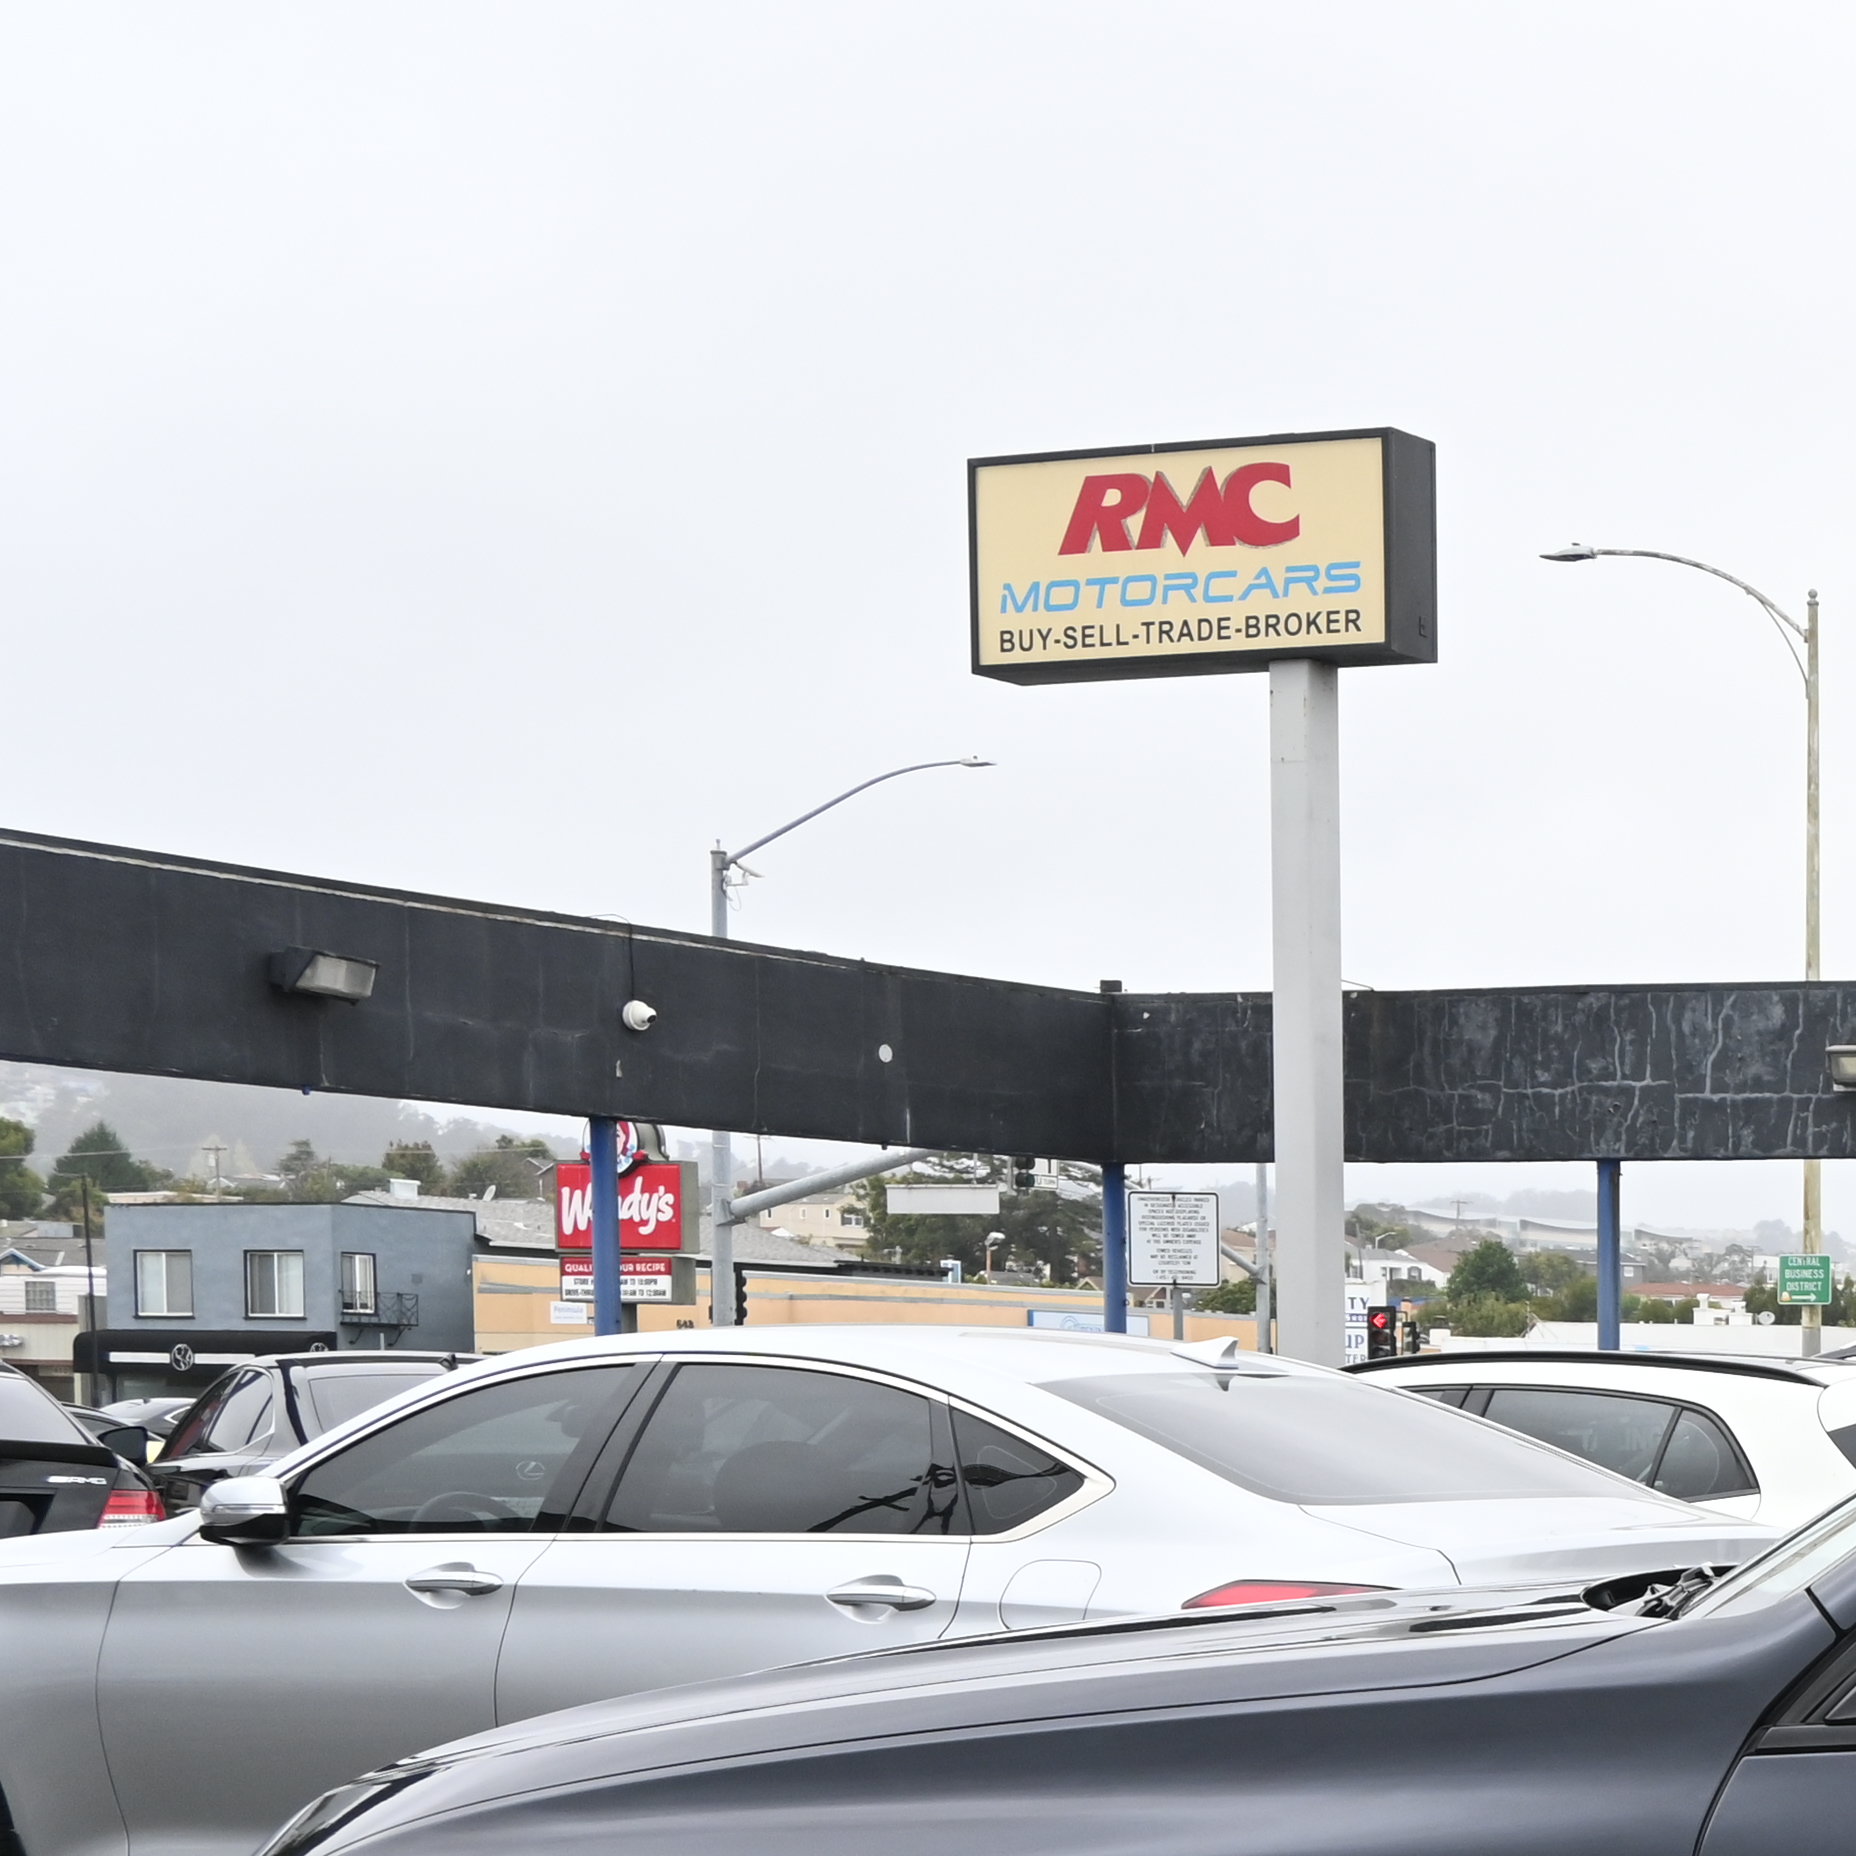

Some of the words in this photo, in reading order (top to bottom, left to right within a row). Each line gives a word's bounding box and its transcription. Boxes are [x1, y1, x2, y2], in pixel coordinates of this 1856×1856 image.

[1058, 461, 1300, 557] RMC
[1000, 561, 1361, 614] MOTORCARS
[999, 609, 1362, 653] BUY-SELL-TRADE-BROKER
[561, 1176, 675, 1235] Wdy's
[565, 1264, 593, 1272] QUALI
[635, 1263, 666, 1272] RECIPE
[1785, 1269, 1824, 1278] BUSINESS
[1786, 1281, 1822, 1291] DISTRICT
